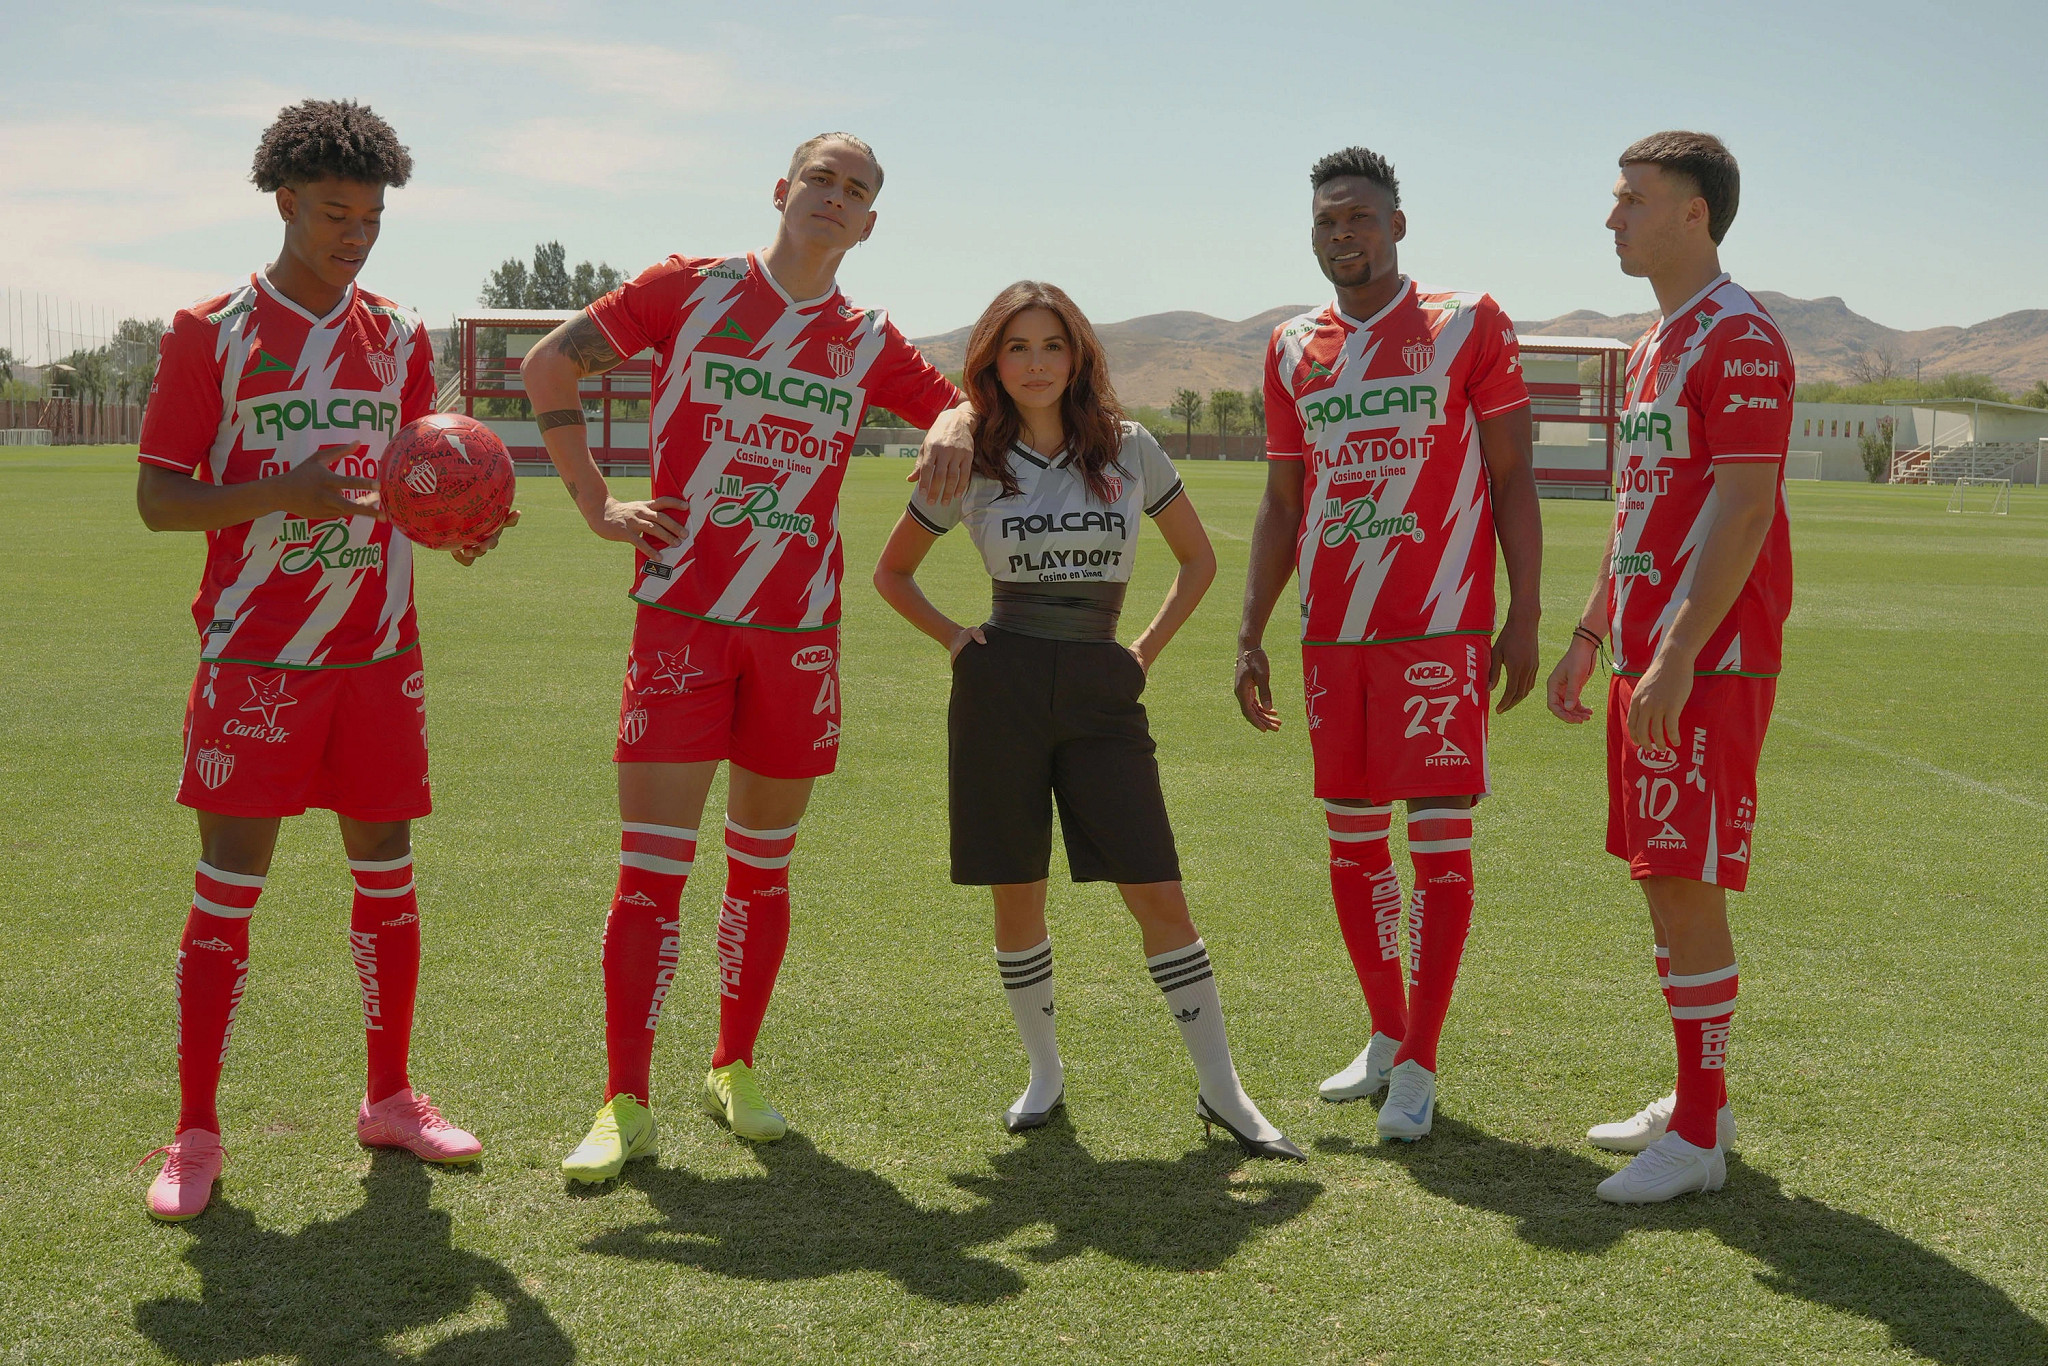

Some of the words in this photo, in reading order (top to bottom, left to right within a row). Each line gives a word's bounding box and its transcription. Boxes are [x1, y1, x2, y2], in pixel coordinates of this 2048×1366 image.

[1724, 359, 1778, 378] Mobil
[705, 361, 853, 427] ROLCAR
[252, 399, 398, 441] ROLCAR
[1305, 385, 1437, 432] ROLCAR
[705, 416, 842, 464] PLAYDOIT
[737, 449, 769, 466] Casino
[772, 458, 784, 468] en
[787, 459, 812, 475] Línea
[1314, 437, 1433, 472] PLAYDOIT
[1333, 470, 1363, 483] Casino
[1365, 470, 1378, 479] en
[1380, 465, 1406, 478] Línea
[714, 476, 743, 497] J.M.
[712, 484, 813, 535] Romo
[1324, 500, 1343, 518] J.M.
[1324, 497, 1415, 544] Romo
[279, 521, 310, 542] J.M.
[1002, 511, 1126, 541] ROLCAR
[282, 521, 380, 572] Romo
[1008, 550, 1122, 573] PLAYDOIT
[1038, 571, 1067, 582] Casino
[1069, 571, 1080, 579] en
[796, 649, 831, 667] NOEL
[1466, 644, 1477, 680] ETN
[1408, 665, 1450, 681] NOEL
[812, 672, 836, 715] 4
[1403, 695, 1460, 739] 27
[222, 718, 266, 740] Carl's
[265, 726, 290, 743] Jr.
[813, 735, 840, 751] PIRM
[1691, 727, 1707, 766] ETN
[200, 751, 232, 764] NECAXA
[1425, 757, 1471, 767] PIRMA
[1640, 749, 1673, 764] NOEL
[1635, 774, 1679, 822] 10
[1647, 840, 1688, 849] PIRMA
[619, 895, 657, 908] PIRMA
[192, 939, 233, 952] PIRMA
